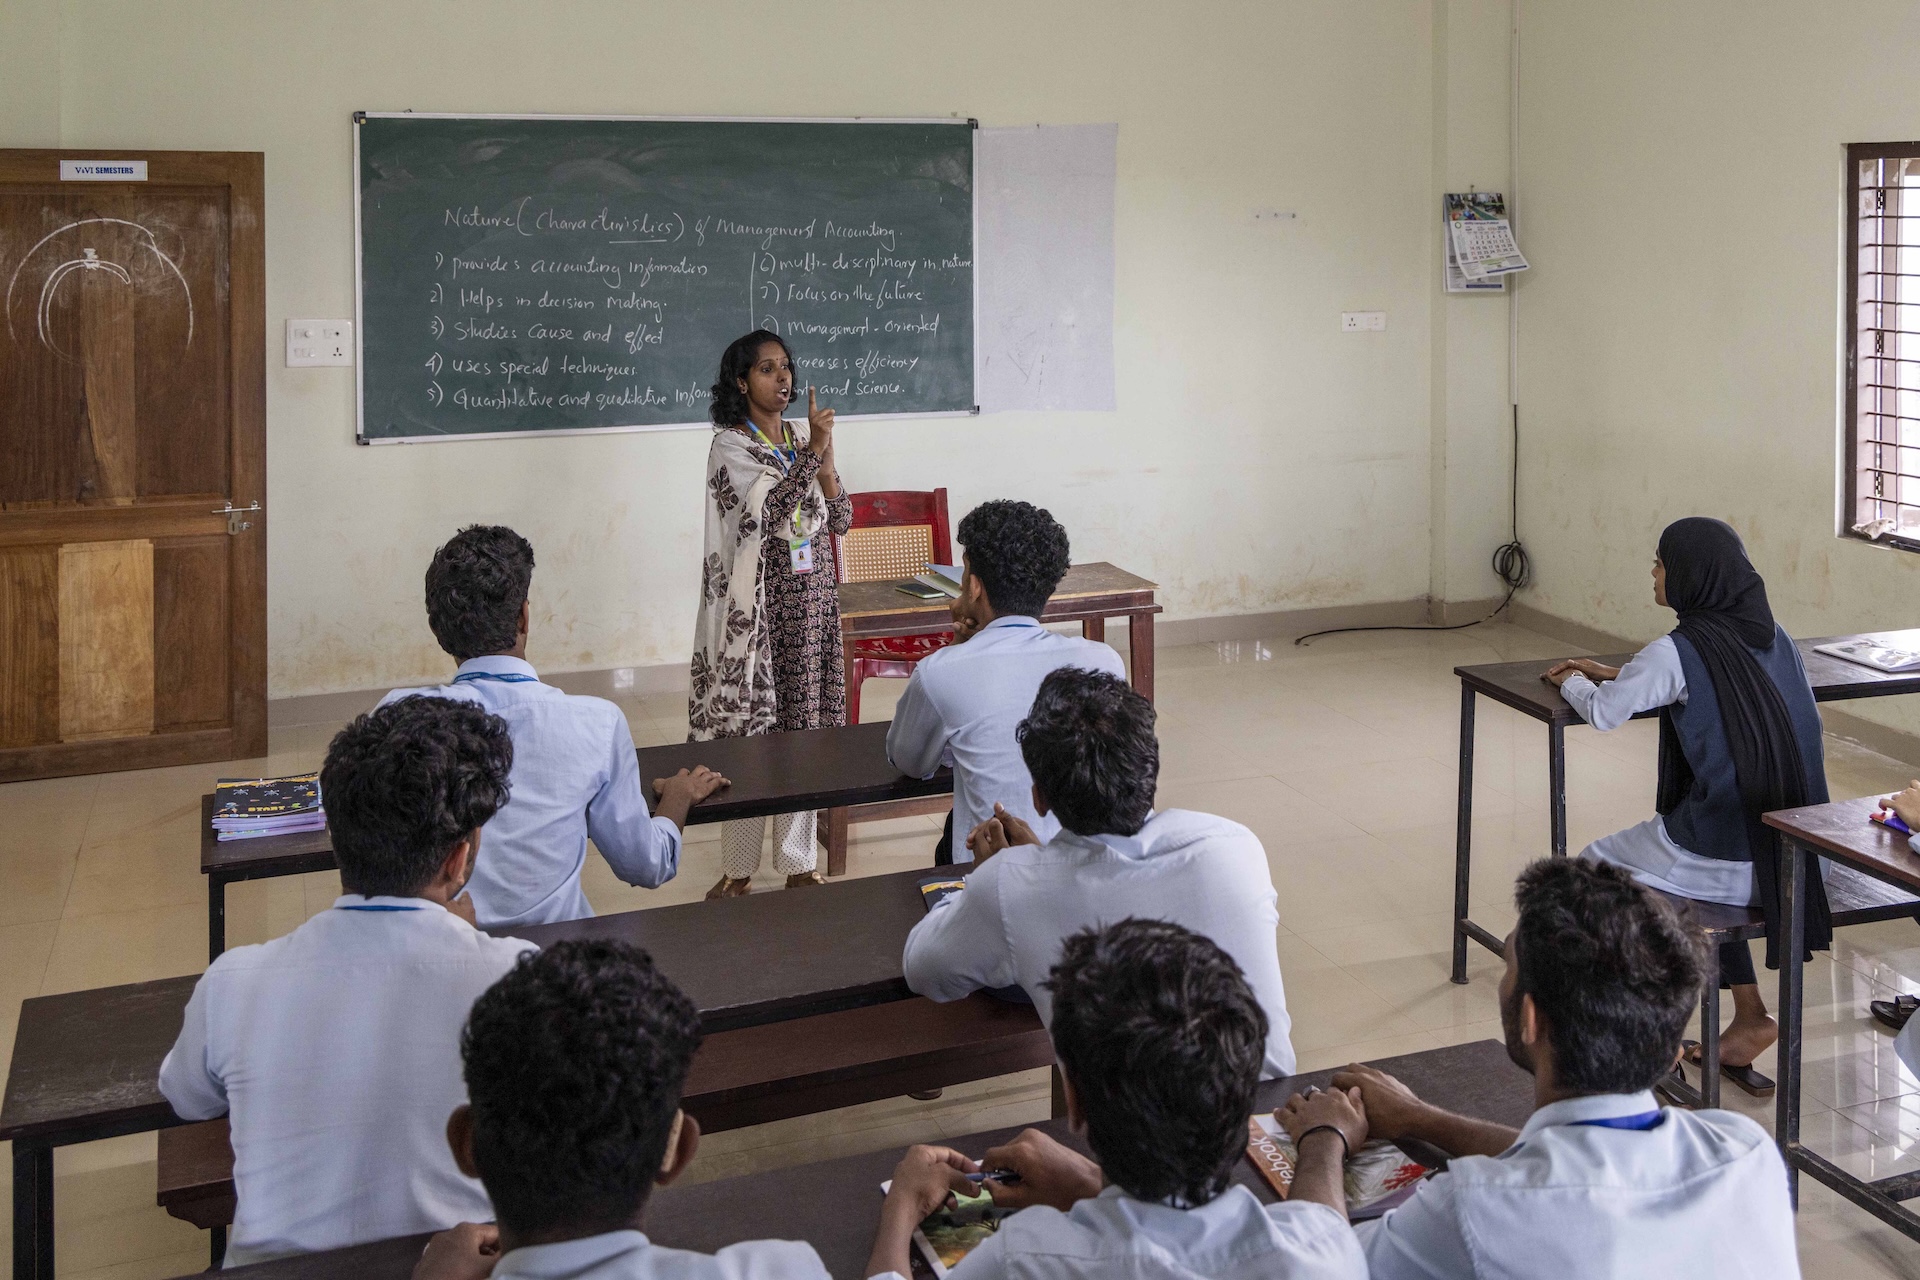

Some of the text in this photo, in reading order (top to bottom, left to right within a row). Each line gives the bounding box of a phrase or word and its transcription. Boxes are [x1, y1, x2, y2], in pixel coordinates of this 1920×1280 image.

[444, 205, 515, 227] Nature
[695, 216, 711, 246] of
[760, 252, 776, 276] 6)
[430, 282, 443, 305] 2)
[461, 287, 503, 314] Helps
[515, 296, 531, 306] in
[538, 290, 595, 309] decision
[760, 280, 780, 304] 7)
[787, 283, 827, 302] Focus
[829, 290, 850, 302] on
[852, 283, 874, 301] the
[431, 315, 444, 340] 3)
[453, 317, 517, 340] Studies
[583, 324, 612, 343] and
[624, 324, 664, 354] effect
[425, 351, 443, 376] 4)
[499, 356, 550, 384] special
[791, 350, 919, 379] creases efficiency
[427, 380, 444, 408] 5)
[453, 387, 553, 410] Quantitative
[558, 391, 591, 409] and
[595, 385, 667, 411] qualitative
[820, 379, 850, 396] and
[1250, 1136, 1295, 1185] tebook
